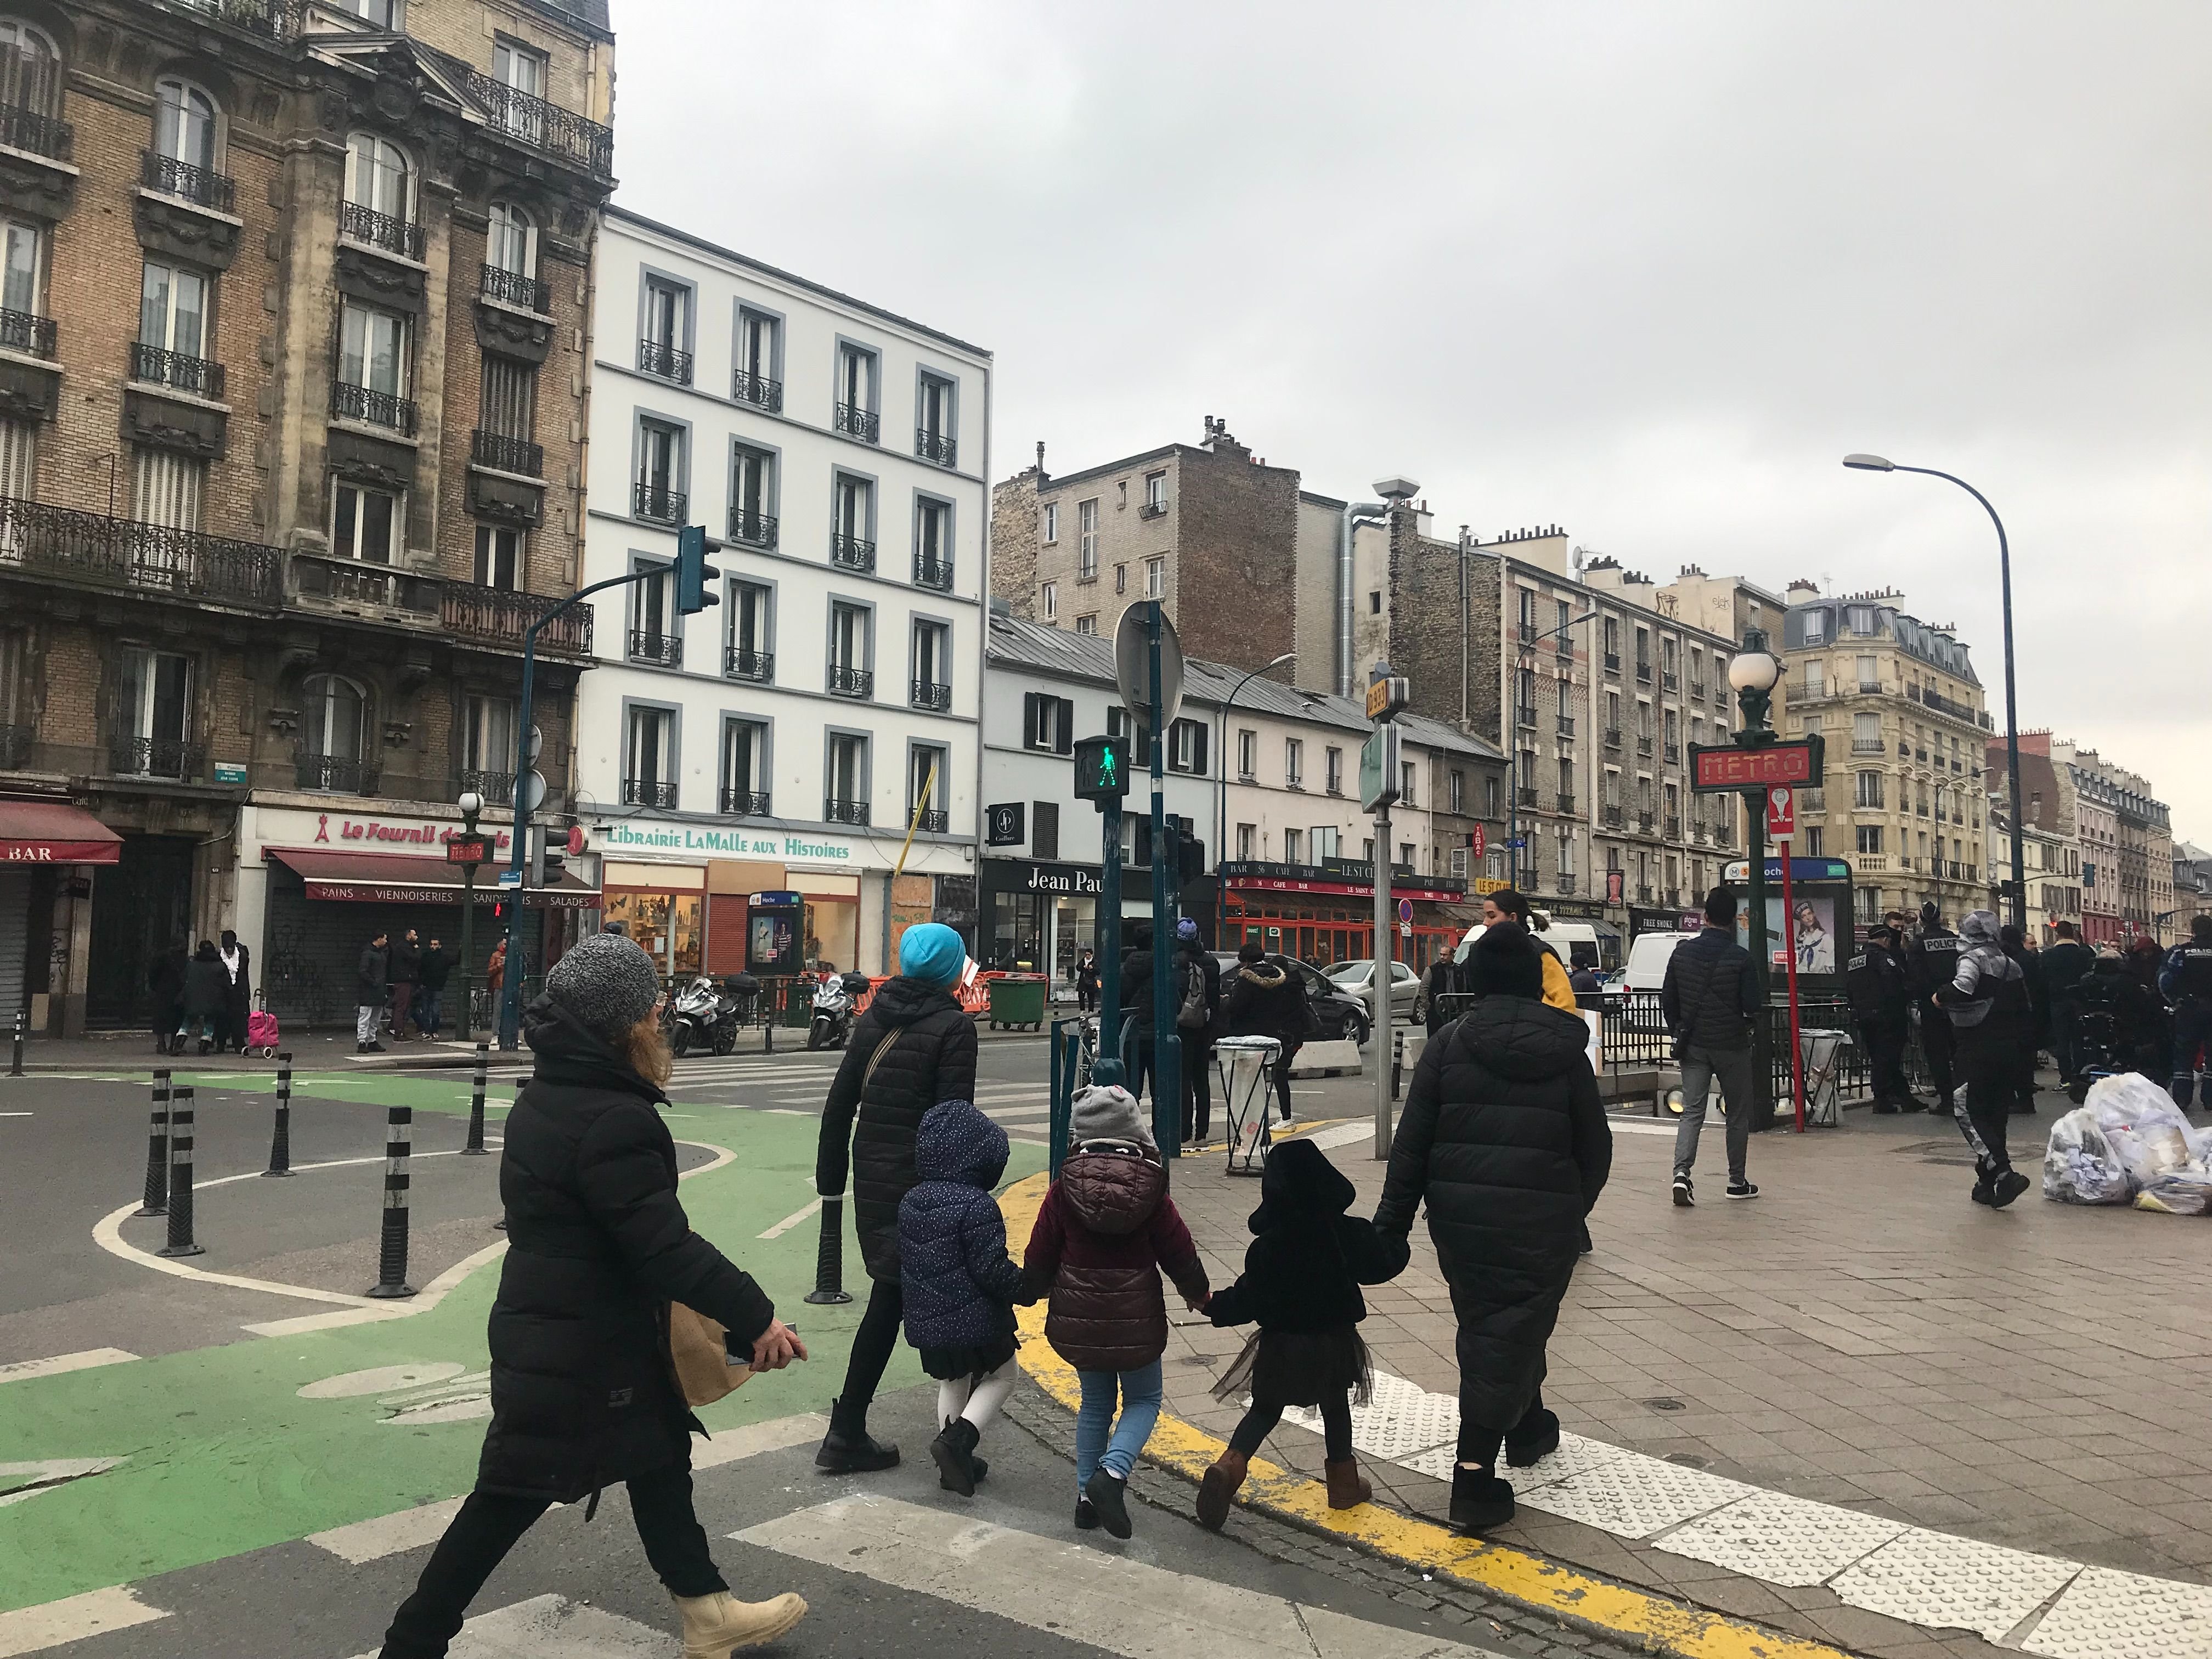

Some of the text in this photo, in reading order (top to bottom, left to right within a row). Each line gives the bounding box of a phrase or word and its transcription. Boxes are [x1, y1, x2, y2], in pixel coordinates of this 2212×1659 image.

[1705, 753, 1803, 781] METRO
[341, 821, 364, 839] Le
[366, 822, 436, 843] Fournil
[9, 847, 52, 861] BAR
[452, 845, 482, 860] METRO
[1230, 865, 1248, 873] BAR
[1257, 865, 1265, 874] 56
[1302, 869, 1315, 878] BAR
[1764, 867, 1784, 876] och
[1028, 867, 1103, 893] Jean Pau
[1480, 880, 1486, 892] LE
[322, 888, 354, 898] PAINS
[375, 889, 453, 902] VIENNOISERIES
[550, 896, 589, 907] SALADES
[1643, 918, 1673, 928] FREE SMOKE
[1927, 939, 1957, 949] POLICE
